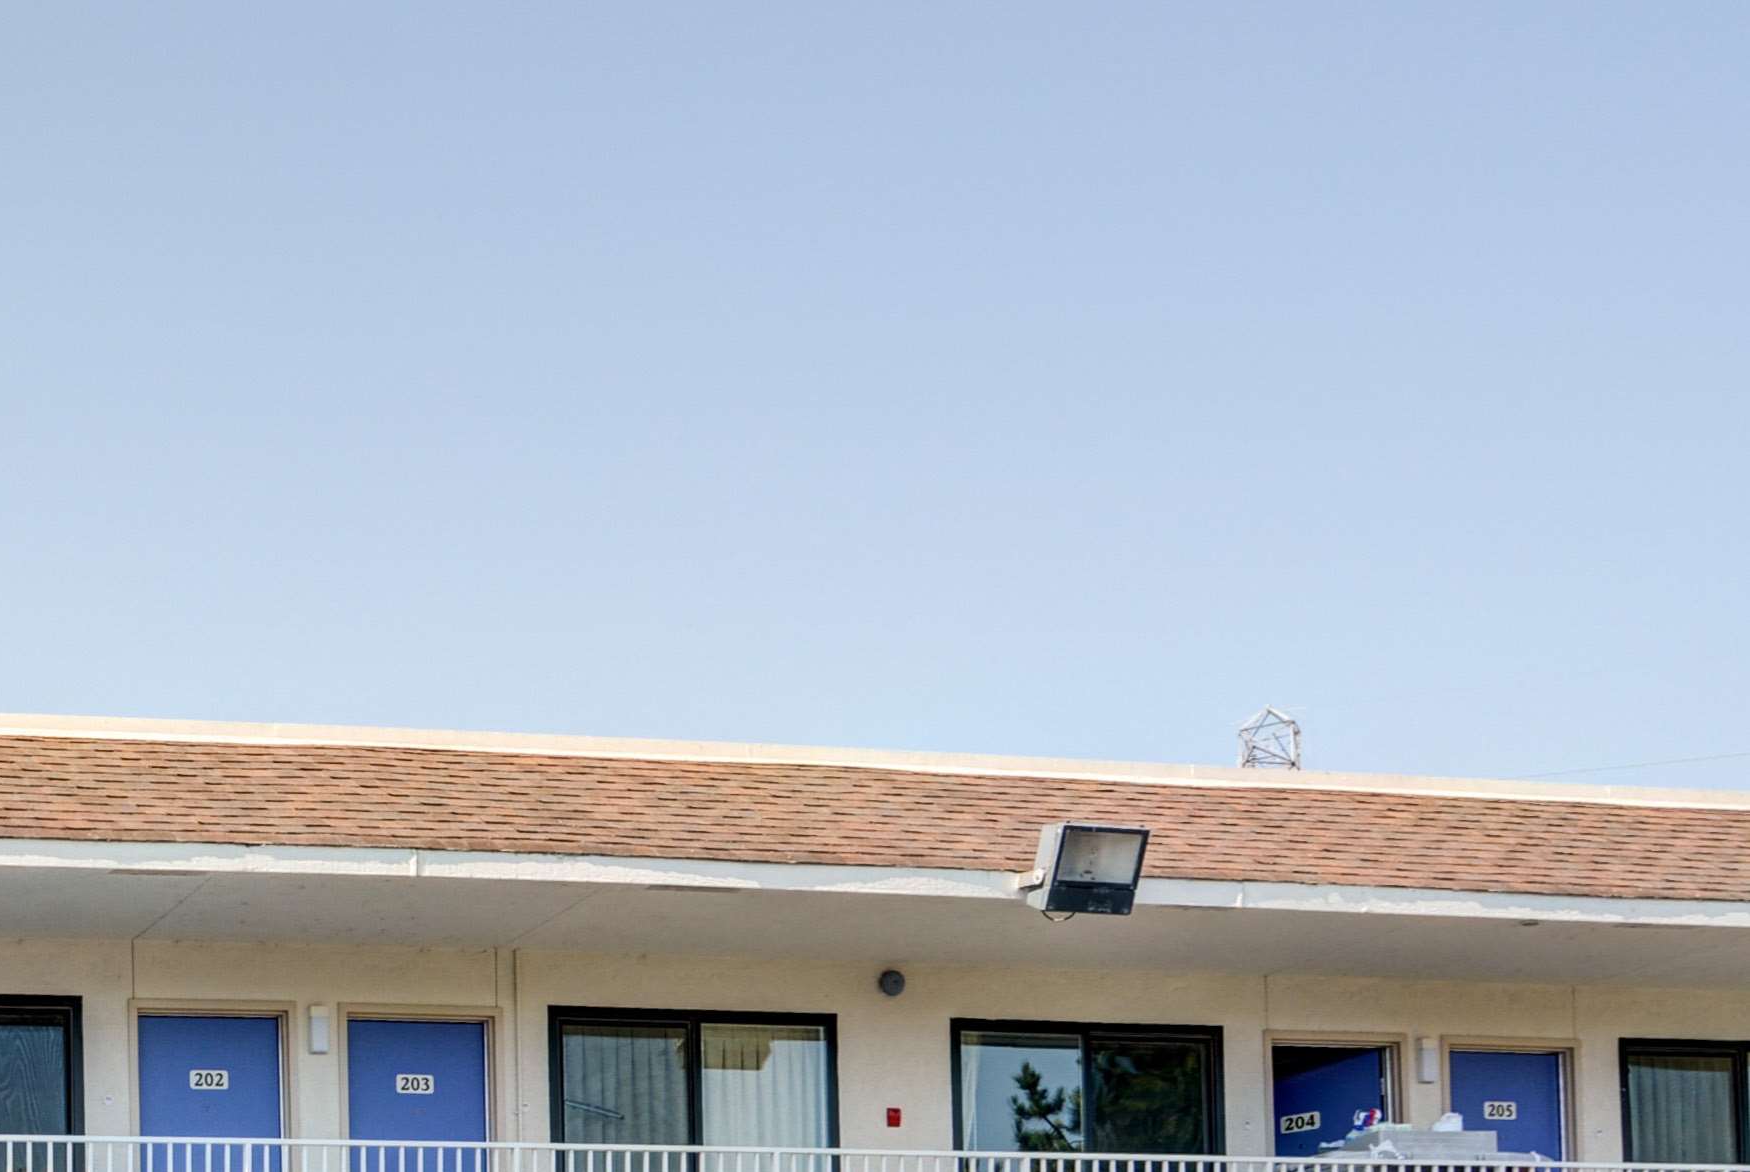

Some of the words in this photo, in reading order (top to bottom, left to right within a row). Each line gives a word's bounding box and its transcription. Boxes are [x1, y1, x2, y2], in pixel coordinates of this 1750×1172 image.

[193, 1072, 225, 1087] 202
[400, 1077, 431, 1091] 203
[1487, 1104, 1514, 1118] 205
[1284, 1114, 1316, 1132] 204
